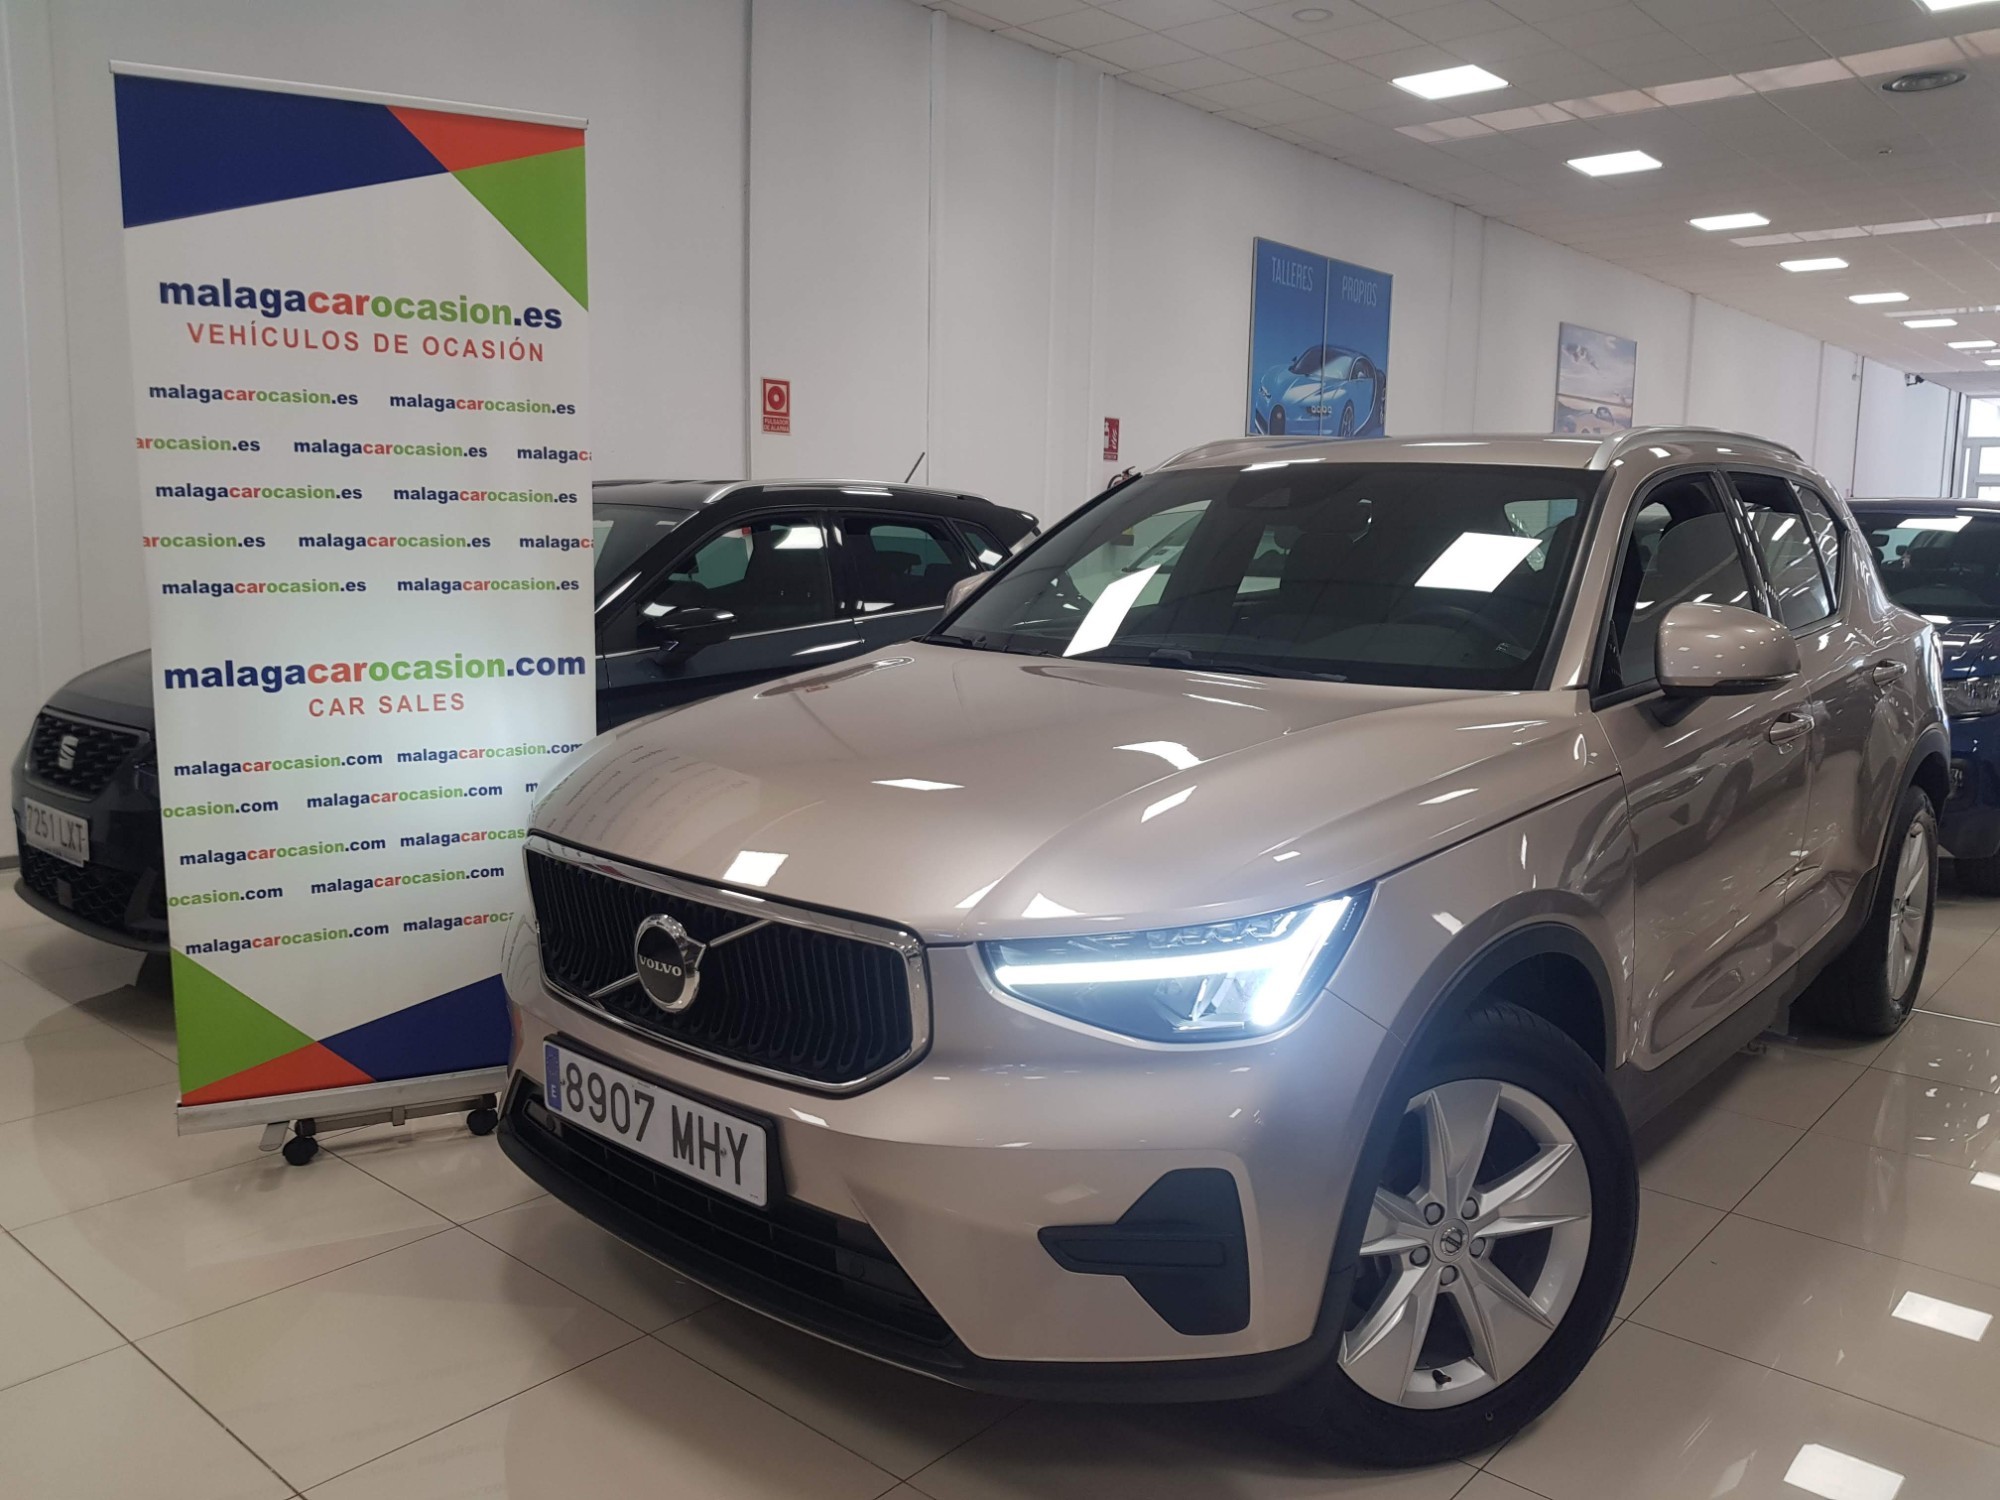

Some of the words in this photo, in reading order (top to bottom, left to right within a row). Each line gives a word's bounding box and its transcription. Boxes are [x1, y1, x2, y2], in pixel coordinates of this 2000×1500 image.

[1271, 256, 1313, 292] TALLERES
[1342, 275, 1377, 306] PROPIOS
[159, 278, 563, 329] malagacarocasion.es
[187, 321, 358, 351] VEHÍCULOS
[374, 333, 408, 354] DE
[423, 336, 543, 362] OCASIÓN
[149, 384, 358, 405] malagacarocasion.es
[390, 394, 575, 414] malagacarocasion.es
[294, 439, 487, 457] malagacarocasion.es
[517, 446, 592, 463] malagac
[156, 483, 362, 501] malagacarocasion.es
[394, 487, 577, 504] malagacarocasion.es
[299, 533, 491, 550] malagacarocasion.es
[520, 535, 593, 551] malagac
[162, 580, 366, 597] malagacarocasion.es
[398, 578, 579, 594] malagacarocasion.es
[164, 653, 586, 693] malagacarocasion.com
[309, 697, 364, 717] CAR
[379, 693, 464, 714] SALES
[174, 754, 382, 777] malagacarocasion.com
[163, 801, 278, 818] ocasion.com
[307, 786, 502, 808] malagacarocasion.com
[27, 805, 56, 842] 7251
[180, 839, 385, 865] malagacarocasion.com
[168, 888, 283, 907] ocasion.com
[311, 867, 504, 894] malagacarocasion.com
[186, 924, 389, 954] malagacarocasion.com
[639, 956, 682, 976] VOLVO
[566, 1062, 655, 1142] 8907
[671, 1104, 748, 1186] MHY
